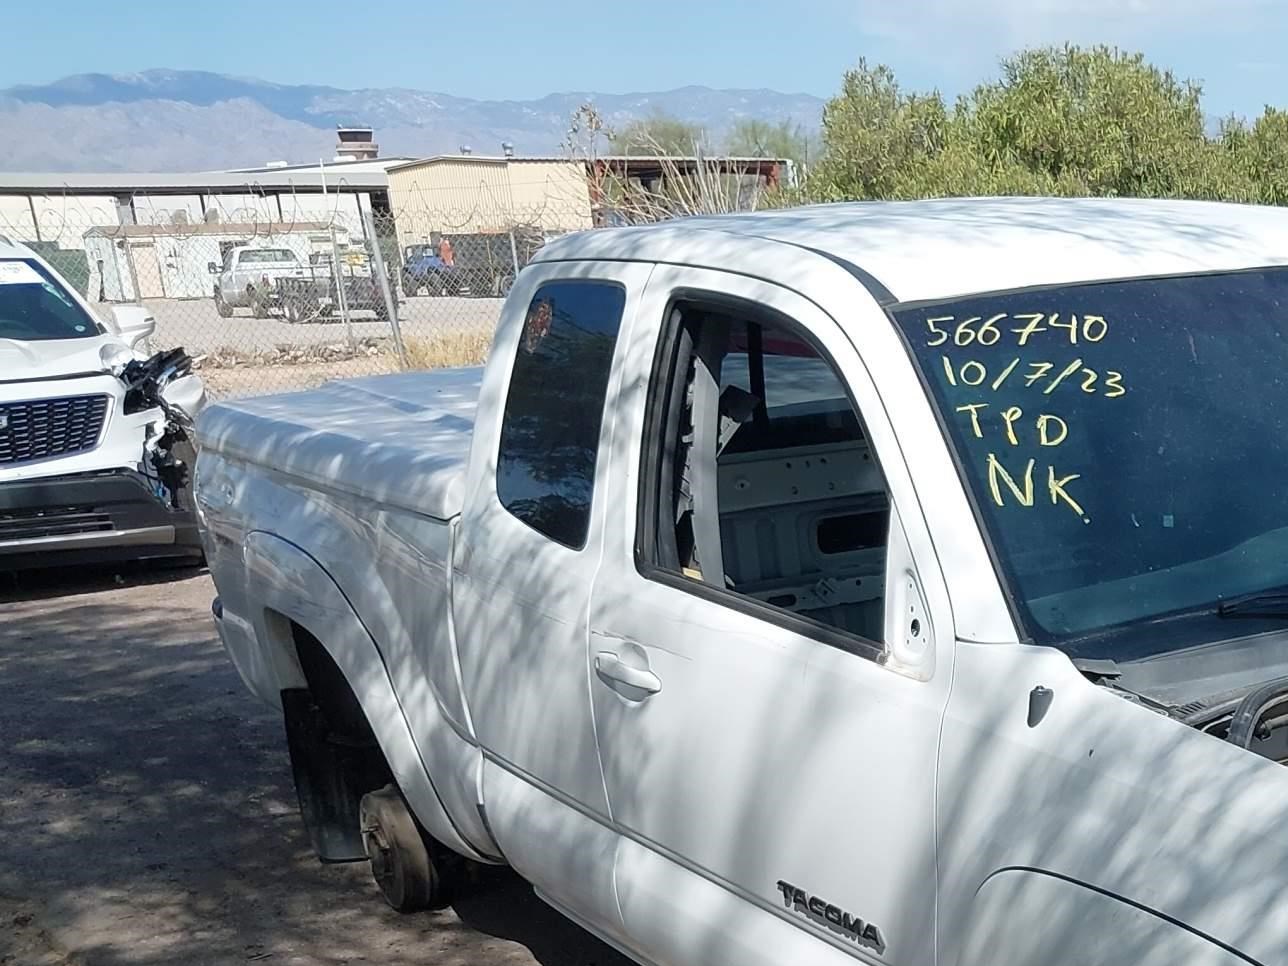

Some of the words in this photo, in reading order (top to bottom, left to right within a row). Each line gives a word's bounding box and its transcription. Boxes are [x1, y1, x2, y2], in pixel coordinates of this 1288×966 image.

[926, 312, 1109, 347] 566740
[942, 355, 1127, 398] 10/7/23
[776, 879, 884, 949] TACOMA
